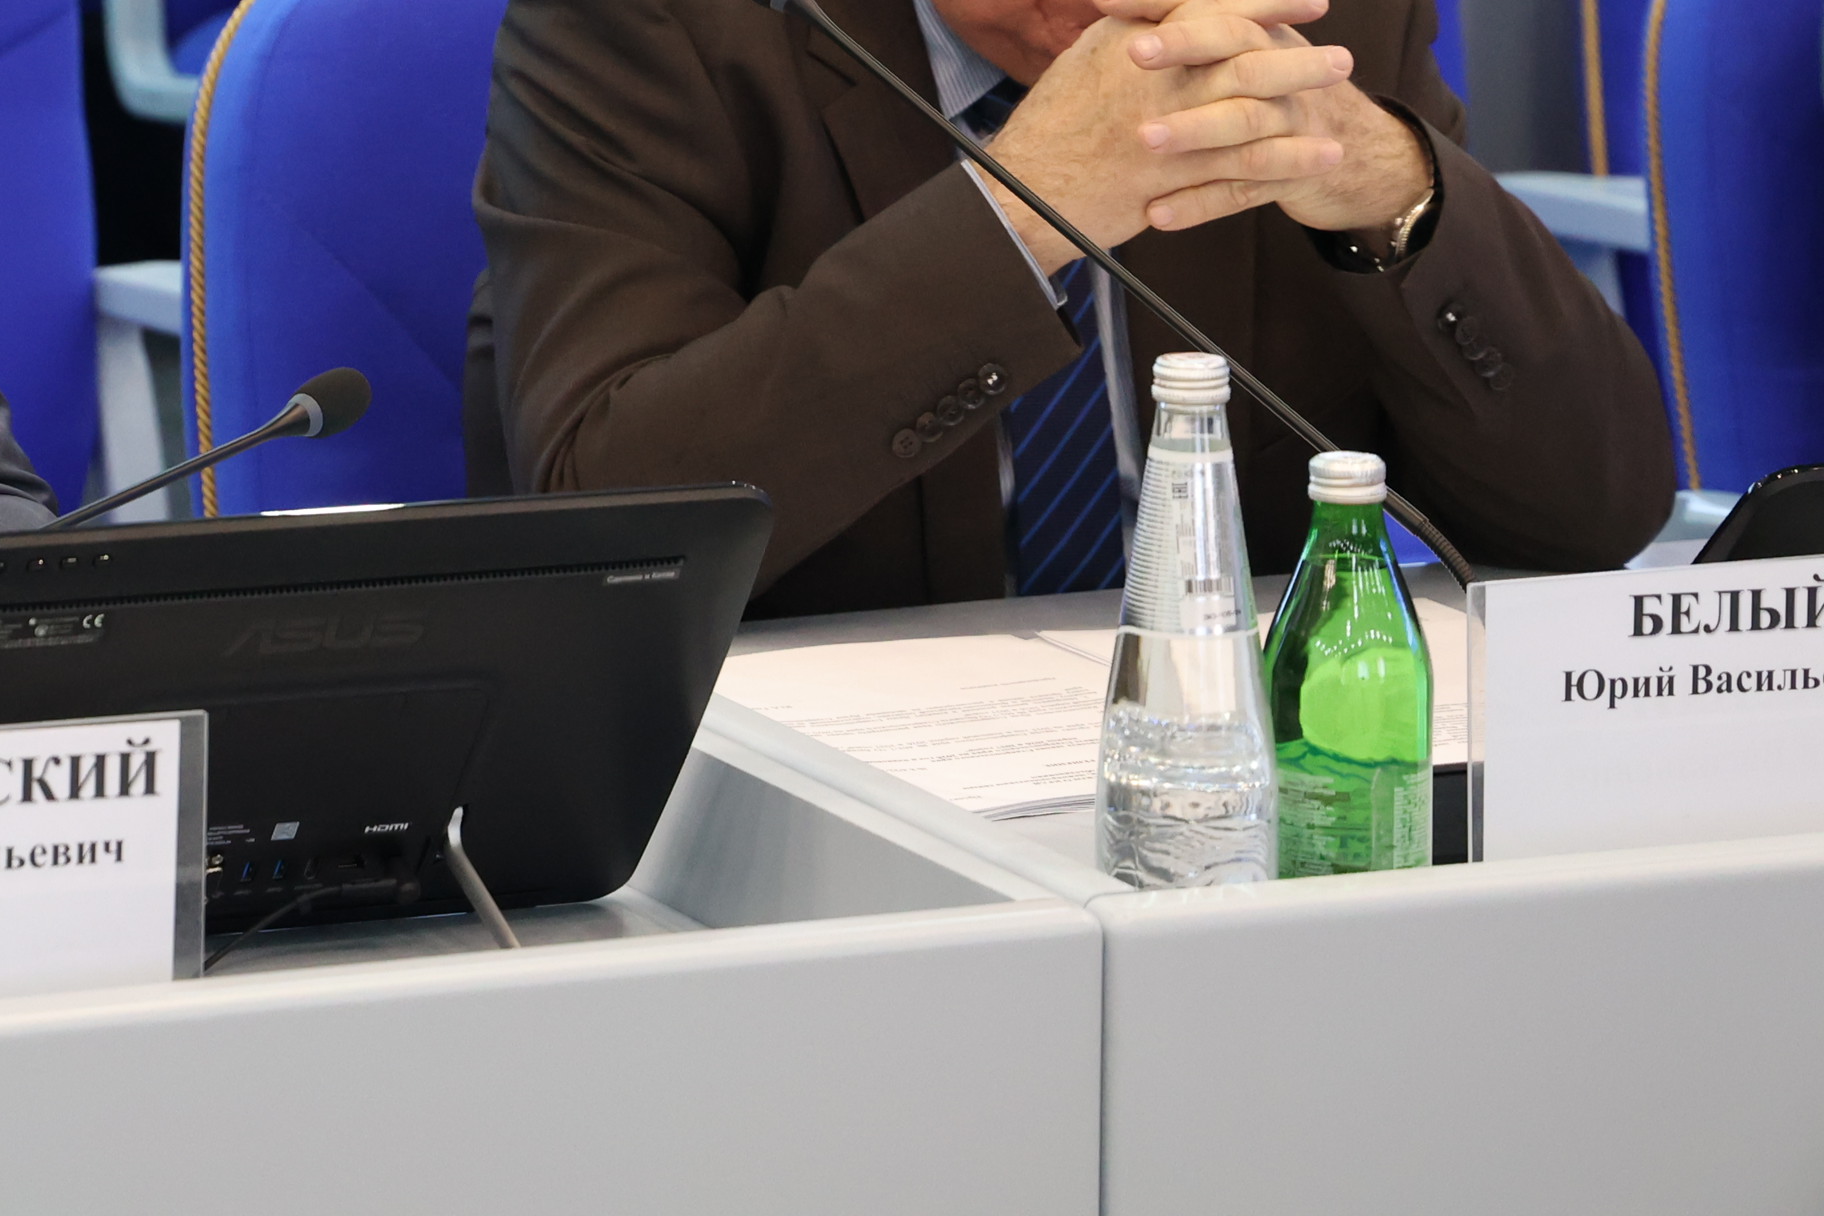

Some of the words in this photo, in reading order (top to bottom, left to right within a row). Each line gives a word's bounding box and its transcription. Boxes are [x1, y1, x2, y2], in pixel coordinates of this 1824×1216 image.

[220, 610, 427, 658] ASUS
[1561, 665, 1676, 710] Юрий
[1688, 663, 1824, 696] Василь
[364, 822, 410, 834] HDMI
